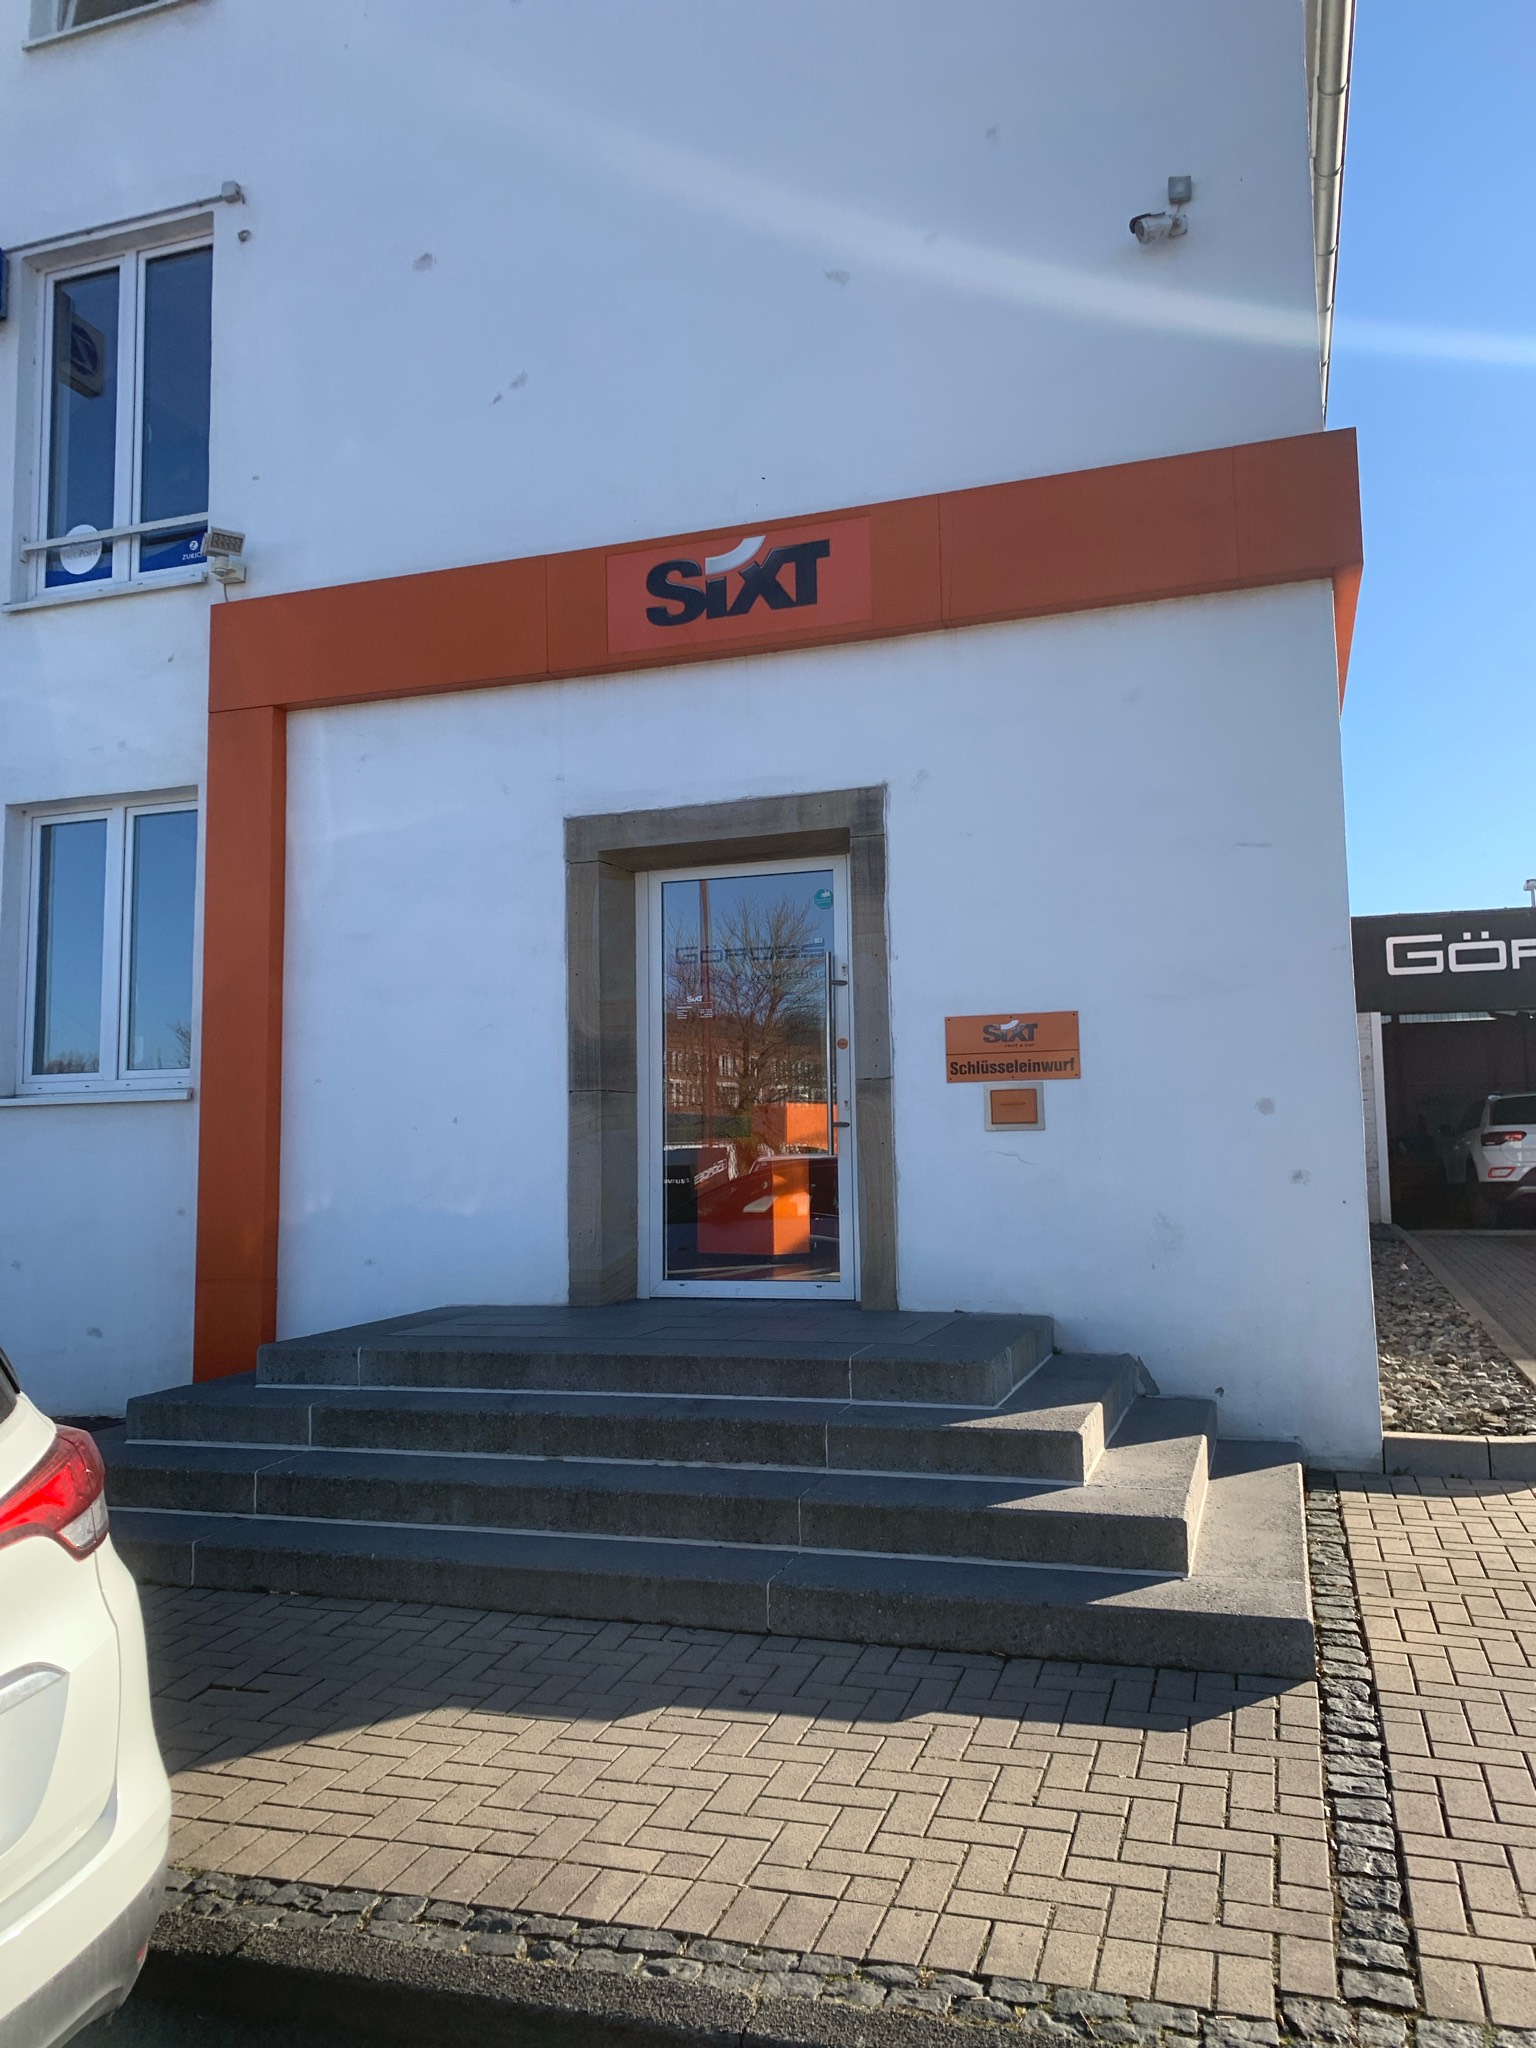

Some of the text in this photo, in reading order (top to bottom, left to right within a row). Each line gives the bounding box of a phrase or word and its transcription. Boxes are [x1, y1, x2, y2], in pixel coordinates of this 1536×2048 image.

[645, 534, 830, 627] SIXT
[983, 1019, 1038, 1043] SIXT
[950, 1057, 1075, 1076] Schlüsseleinwurf
